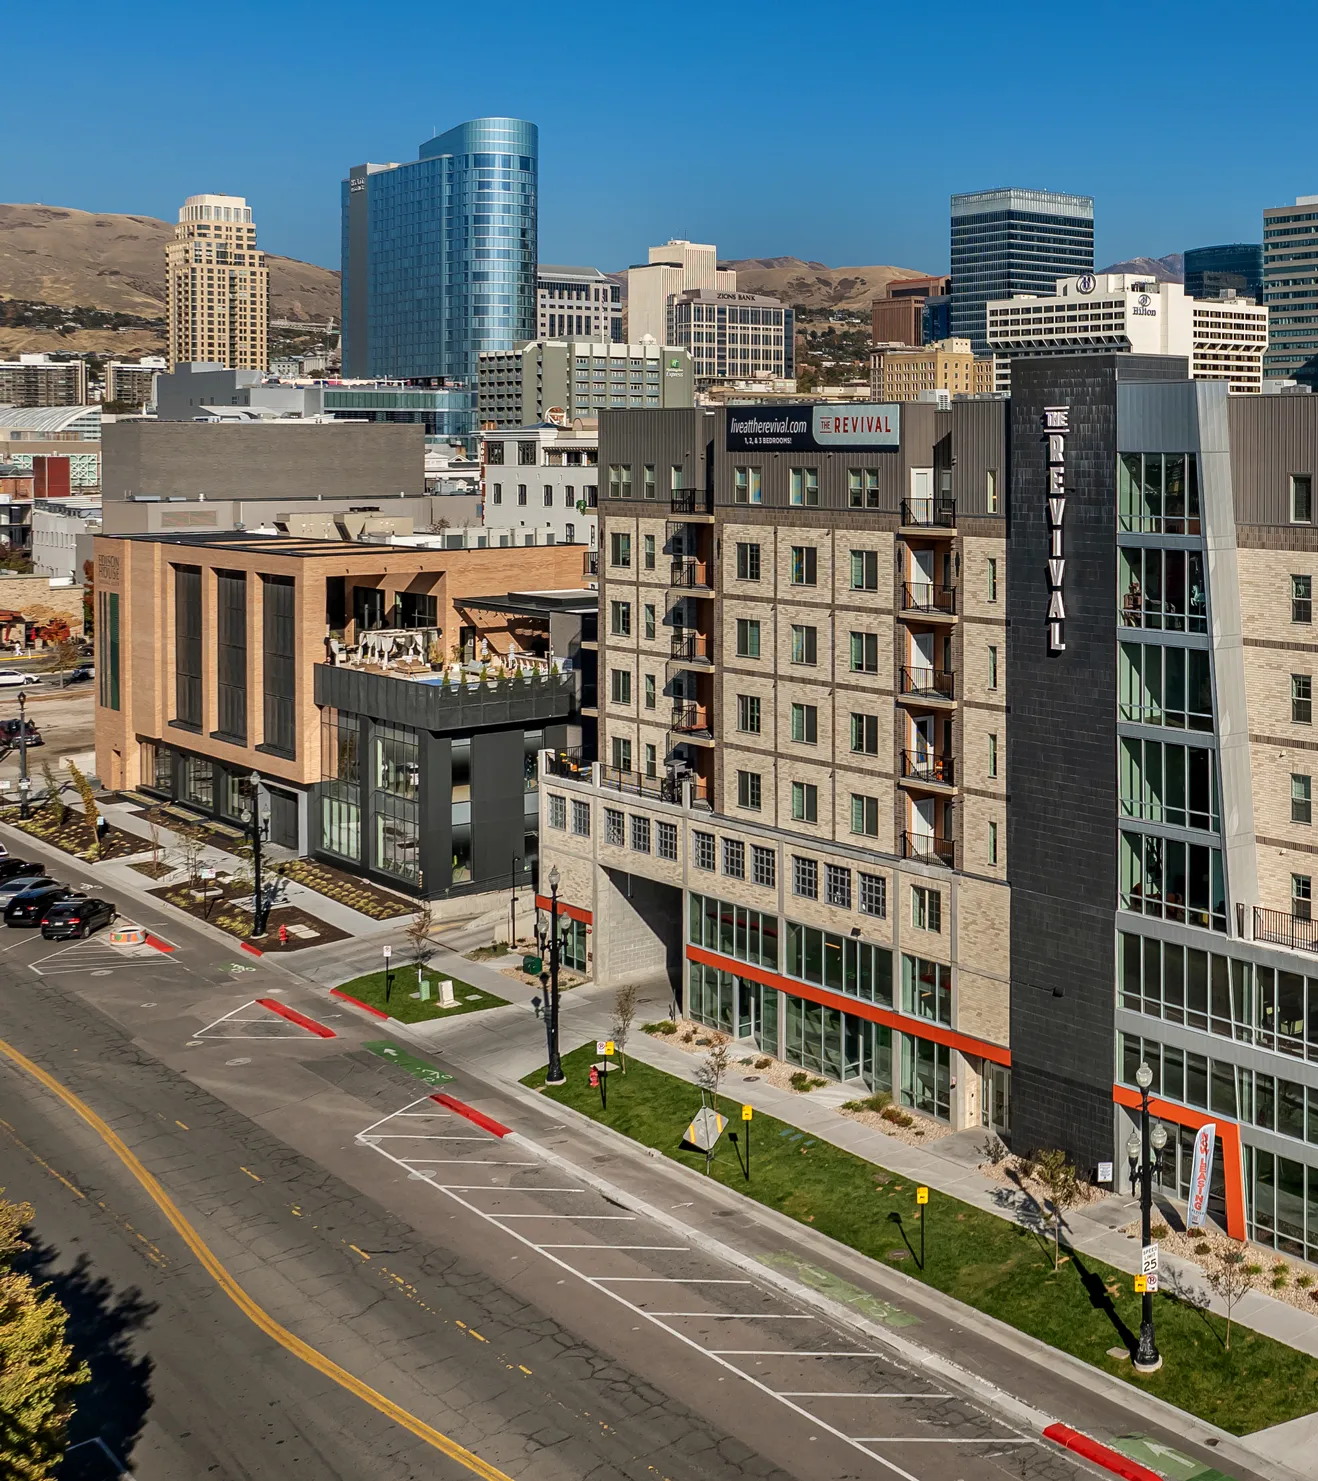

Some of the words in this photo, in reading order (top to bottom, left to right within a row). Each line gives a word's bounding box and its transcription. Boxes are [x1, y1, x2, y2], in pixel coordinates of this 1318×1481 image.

[1132, 306, 1157, 316] Hilton
[730, 416, 807, 434] liveattherevival.com
[821, 420, 831, 430] THE
[834, 416, 892, 433] REVIVAL
[1046, 411, 1068, 427] THE
[1048, 434, 1066, 651] REVIVAL
[98, 554, 120, 567] EDISON
[99, 566, 120, 580] HOUSE
[1194, 1157, 1207, 1211] LEASING
[1143, 1246, 1157, 1255] SPEED
[1144, 1252, 1156, 1260] LIMIT
[1143, 1258, 1157, 1272] 25
